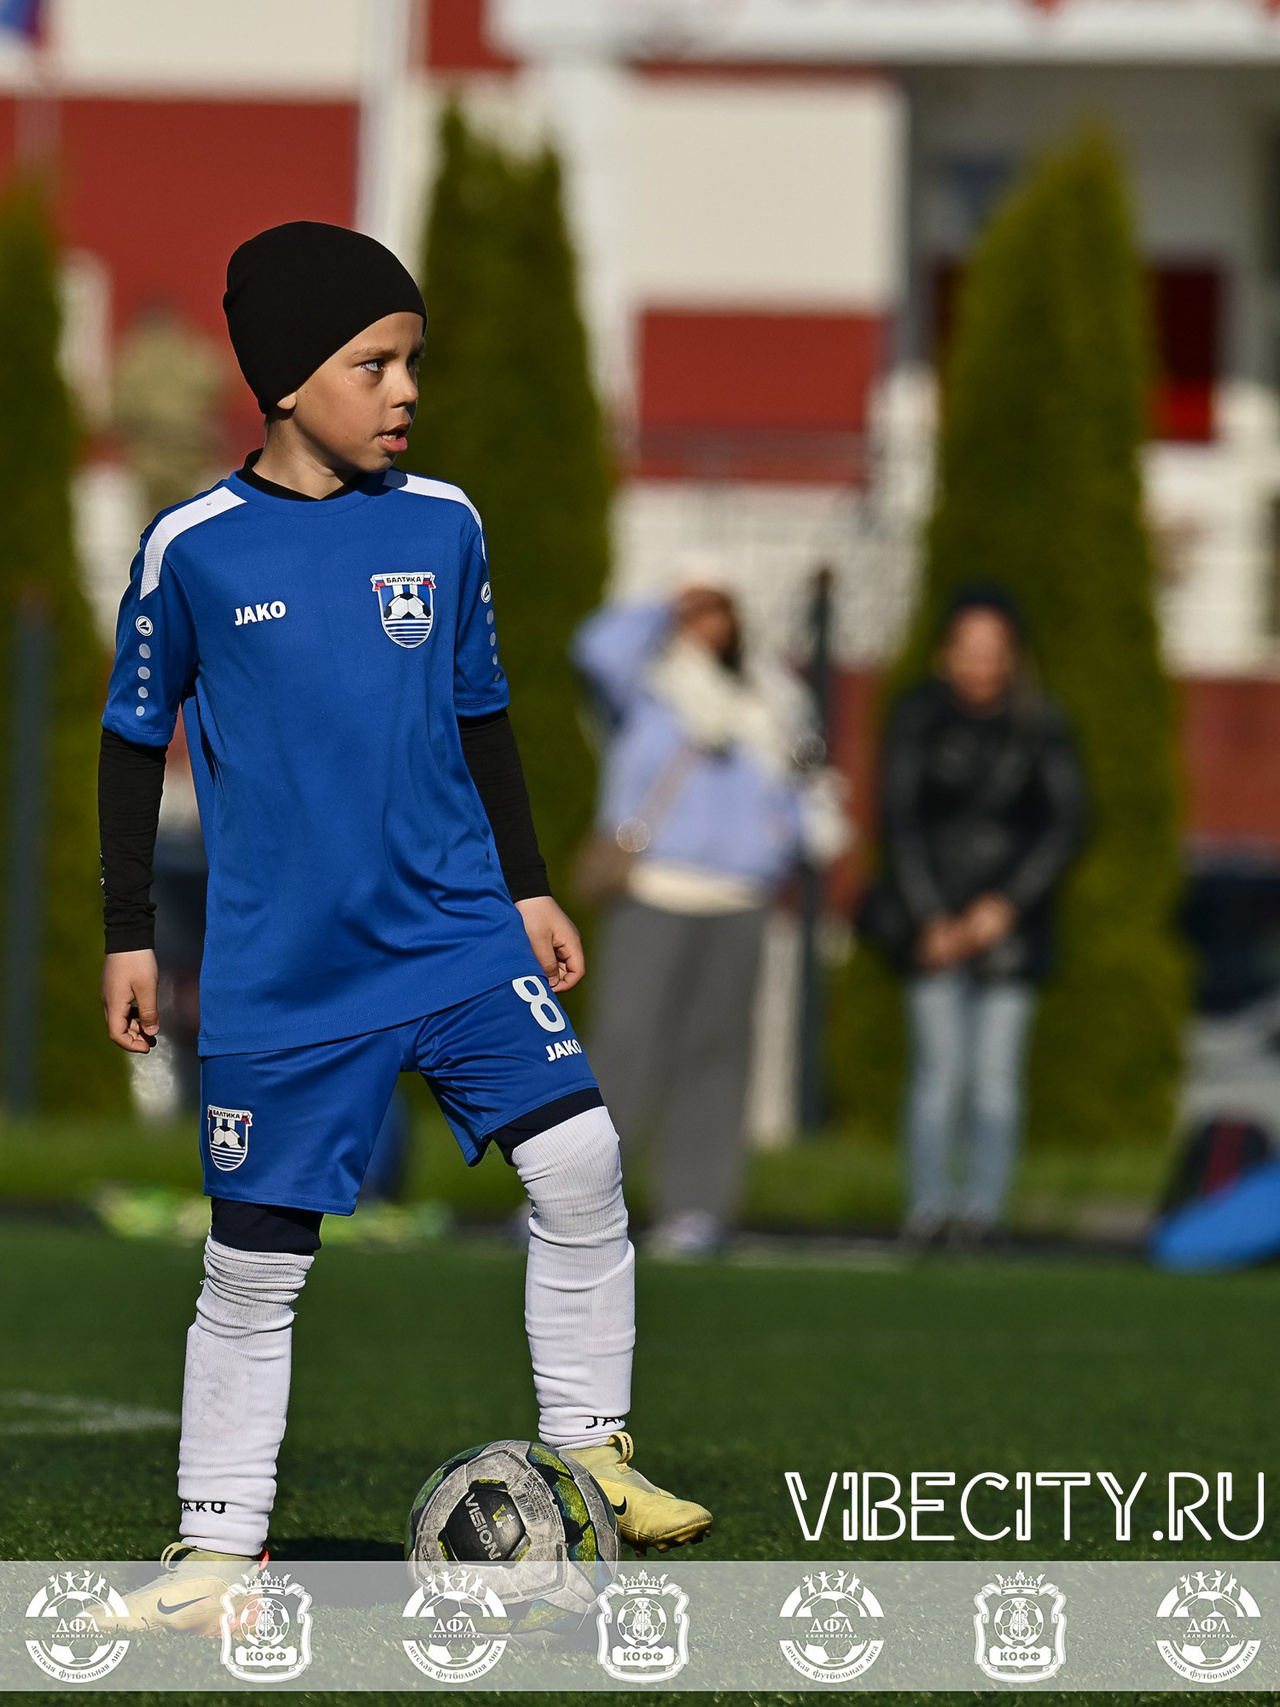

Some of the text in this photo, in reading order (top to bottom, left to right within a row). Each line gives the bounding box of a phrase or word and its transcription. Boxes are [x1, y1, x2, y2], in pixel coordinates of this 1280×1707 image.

[234, 600, 287, 626] JAKO
[512, 975, 566, 1033] 8
[545, 1039, 583, 1062] JAKO
[181, 1500, 226, 1514] AKO
[464, 1492, 502, 1561] VISION
